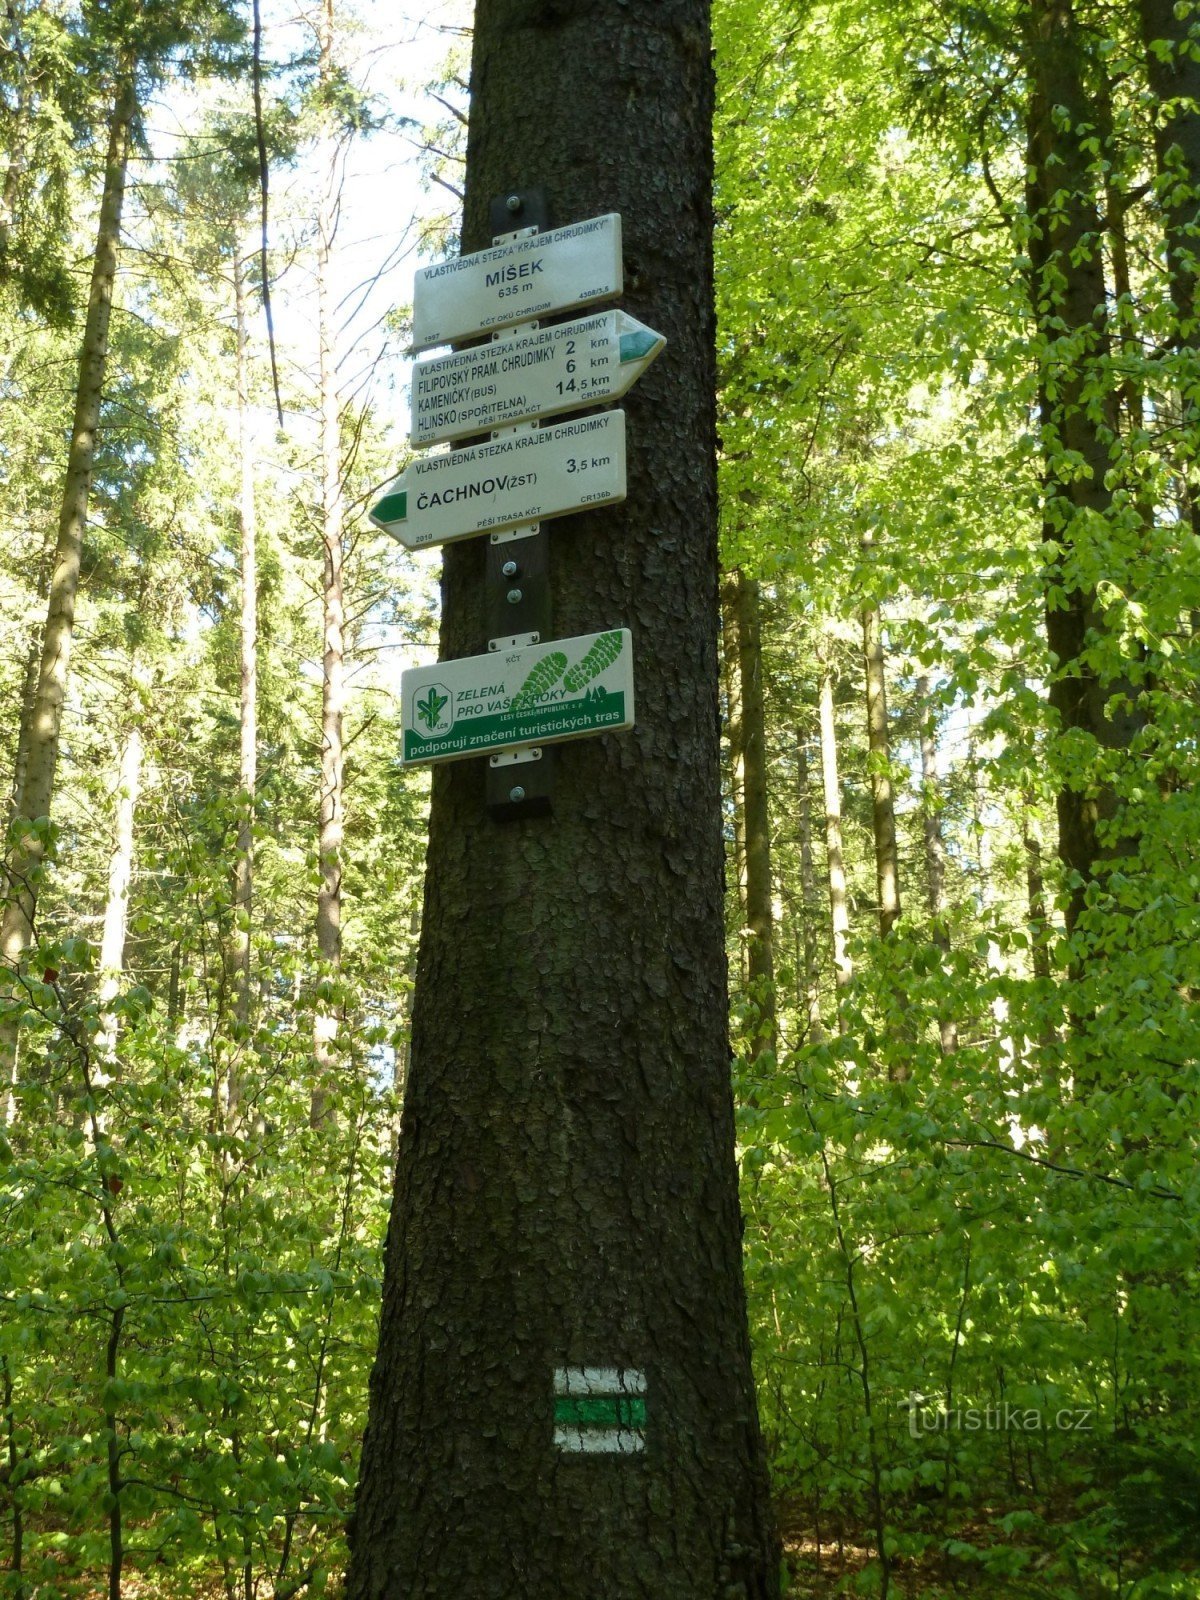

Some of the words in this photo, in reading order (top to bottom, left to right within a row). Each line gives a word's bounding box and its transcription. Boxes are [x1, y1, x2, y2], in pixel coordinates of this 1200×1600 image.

[424, 254, 480, 280] VLASTIVĚDNÁ
[482, 246, 514, 262] STEZKA
[486, 258, 544, 288] MÍŠEK
[498, 286, 519, 298] 635
[522, 282, 532, 292] m
[480, 317, 496, 326] KČT
[516, 302, 550, 316] CHRUDIM
[480, 344, 514, 360] STEZKA
[516, 332, 552, 351] KRAJEM
[555, 318, 608, 340] CHRUDIMKY
[418, 366, 469, 394] FILIPOVSKÝ
[472, 362, 500, 380] PRAM.
[502, 346, 556, 372] CHRUDIMKY
[566, 340, 576, 355] 2
[590, 338, 608, 348] km
[566, 359, 576, 373] 6
[590, 357, 608, 368] km
[556, 378, 588, 395] 14,5
[592, 376, 610, 386] km
[498, 410, 524, 420] TRASA
[526, 404, 541, 414] KČT
[416, 450, 476, 475] VLASTIVĚDNÁ
[478, 442, 513, 458] STEZKA
[516, 432, 552, 450] KRAJEM
[554, 418, 610, 440] CHRUDIMKY
[420, 432, 435, 442] 2010
[566, 458, 588, 474] 3,5
[592, 455, 610, 468] km
[498, 512, 523, 522] TRASA
[526, 506, 541, 516] KČT
[416, 534, 432, 542] 2010
[456, 681, 505, 702] ZELENÁ
[457, 704, 484, 718] PRO
[522, 689, 567, 705] KROKY
[410, 736, 466, 757] podporují
[470, 727, 516, 744] značení
[520, 715, 592, 735] turistických
[595, 712, 620, 722] tras
